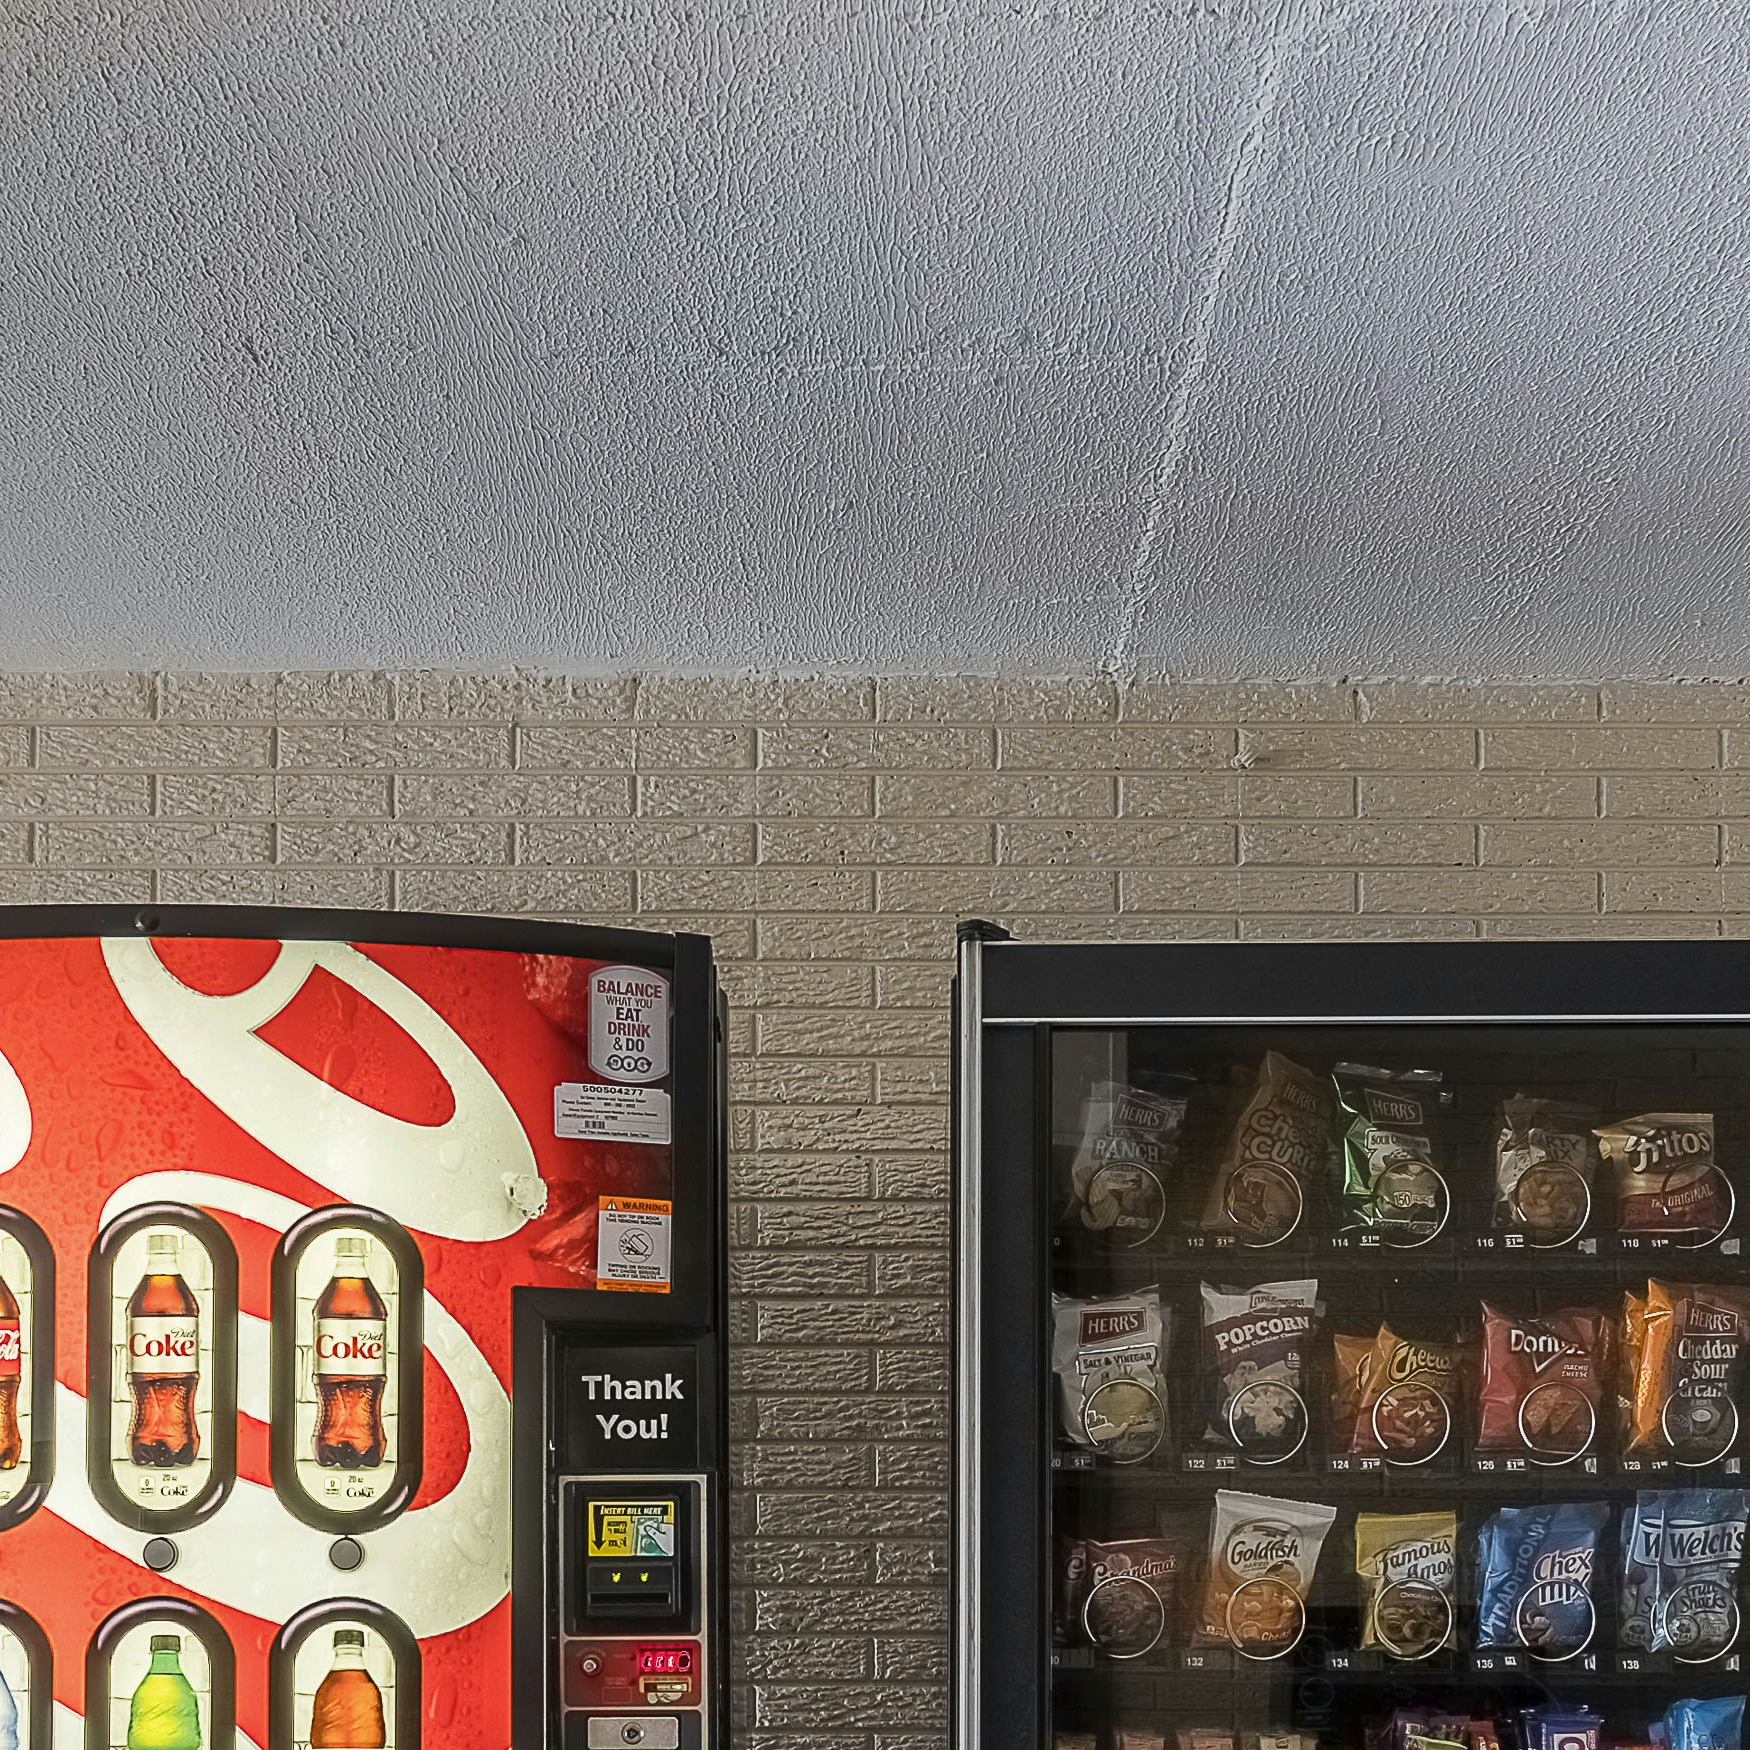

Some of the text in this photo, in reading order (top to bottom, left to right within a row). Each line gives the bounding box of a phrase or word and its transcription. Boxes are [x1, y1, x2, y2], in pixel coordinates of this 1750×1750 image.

[596, 979, 662, 999] BALANCE
[605, 995, 653, 1009] WHAT YOU
[607, 1021, 651, 1039] DRINK
[613, 1037, 645, 1053] & DO
[582, 1085, 644, 1097] 500504277
[1118, 1103, 1163, 1127] HERR'S
[1095, 1137, 1159, 1164] RANCH
[1622, 1129, 1711, 1174] Fritos
[1667, 1183, 1714, 1207] ORIGINAL
[621, 1201, 669, 1213] WARNING
[1187, 1238, 1205, 1247] 112
[1331, 1238, 1349, 1248] 114
[1087, 1312, 1139, 1336] HERR'S
[1689, 1308, 1731, 1332] HERR'S
[170, 1327, 195, 1340] Diet
[357, 1330, 383, 1343] Diet
[1215, 1315, 1311, 1351] POPCORN
[129, 1332, 195, 1358] Coke
[316, 1333, 382, 1360] Coke
[1678, 1337, 1739, 1360] Cheddar
[1083, 1352, 1153, 1370] SALT & VINEGAR
[1691, 1360, 1730, 1380] Sour
[582, 1373, 684, 1401] Thank
[596, 1414, 668, 1440] You!
[1188, 1459, 1205, 1469] 122
[1332, 1459, 1350, 1469] 124
[160, 1486, 188, 1496] Coke
[346, 1487, 375, 1498] Coke
[600, 1505, 626, 1515] INSERT
[627, 1507, 641, 1515] BILL
[1230, 1537, 1300, 1566] Goldfish
[1668, 1526, 1746, 1560] Welch's
[1376, 1537, 1452, 1576] Famous
[1533, 1547, 1594, 1583] Chex
[1487, 1512, 1553, 1630] TRADITIONAL
[1186, 1657, 1204, 1667] 132
[1332, 1658, 1350, 1668] 134
